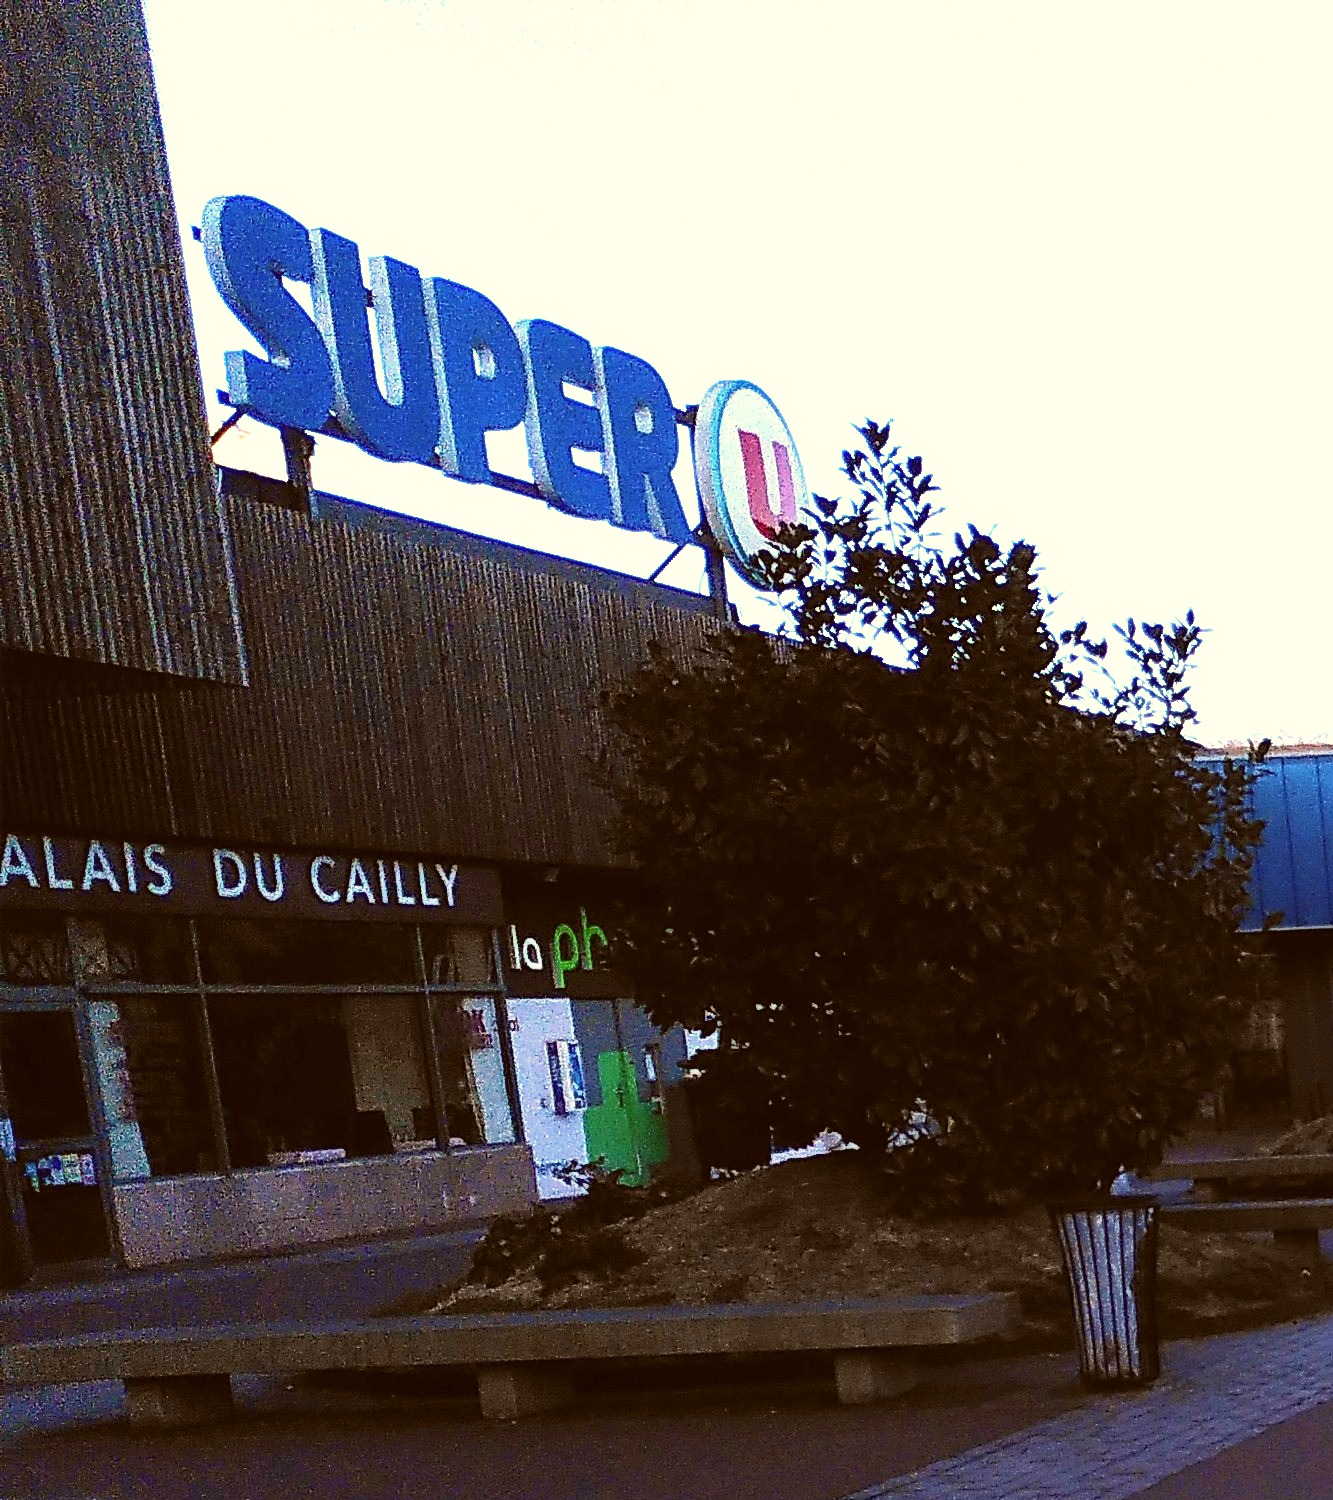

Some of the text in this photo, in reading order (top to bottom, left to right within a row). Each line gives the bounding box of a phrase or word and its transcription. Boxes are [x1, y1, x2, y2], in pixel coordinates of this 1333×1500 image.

[201, 195, 695, 545] SUPER
[0, 833, 460, 908] ALAIS DU CAILLY
[510, 924, 543, 971] la
